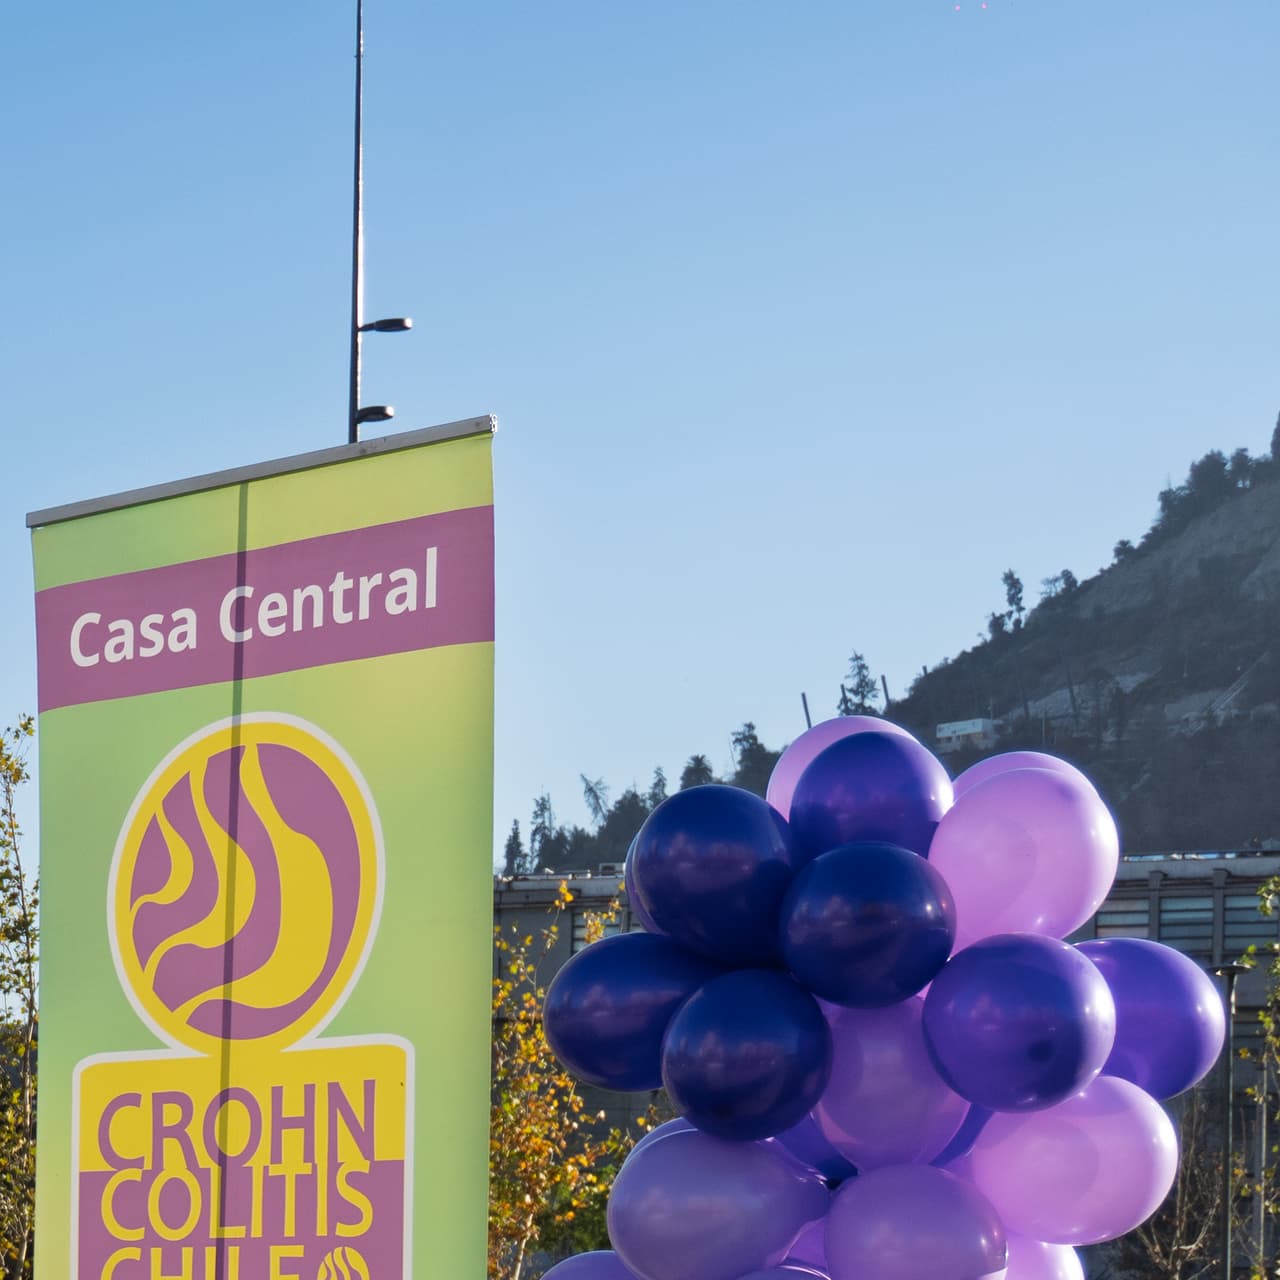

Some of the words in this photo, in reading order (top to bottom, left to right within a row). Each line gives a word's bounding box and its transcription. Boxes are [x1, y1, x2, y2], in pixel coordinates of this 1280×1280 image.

[70, 608, 198, 668] Casa
[219, 546, 439, 644] Central
[97, 1079, 376, 1171] CROHN
[100, 1159, 374, 1241] COLITIS
